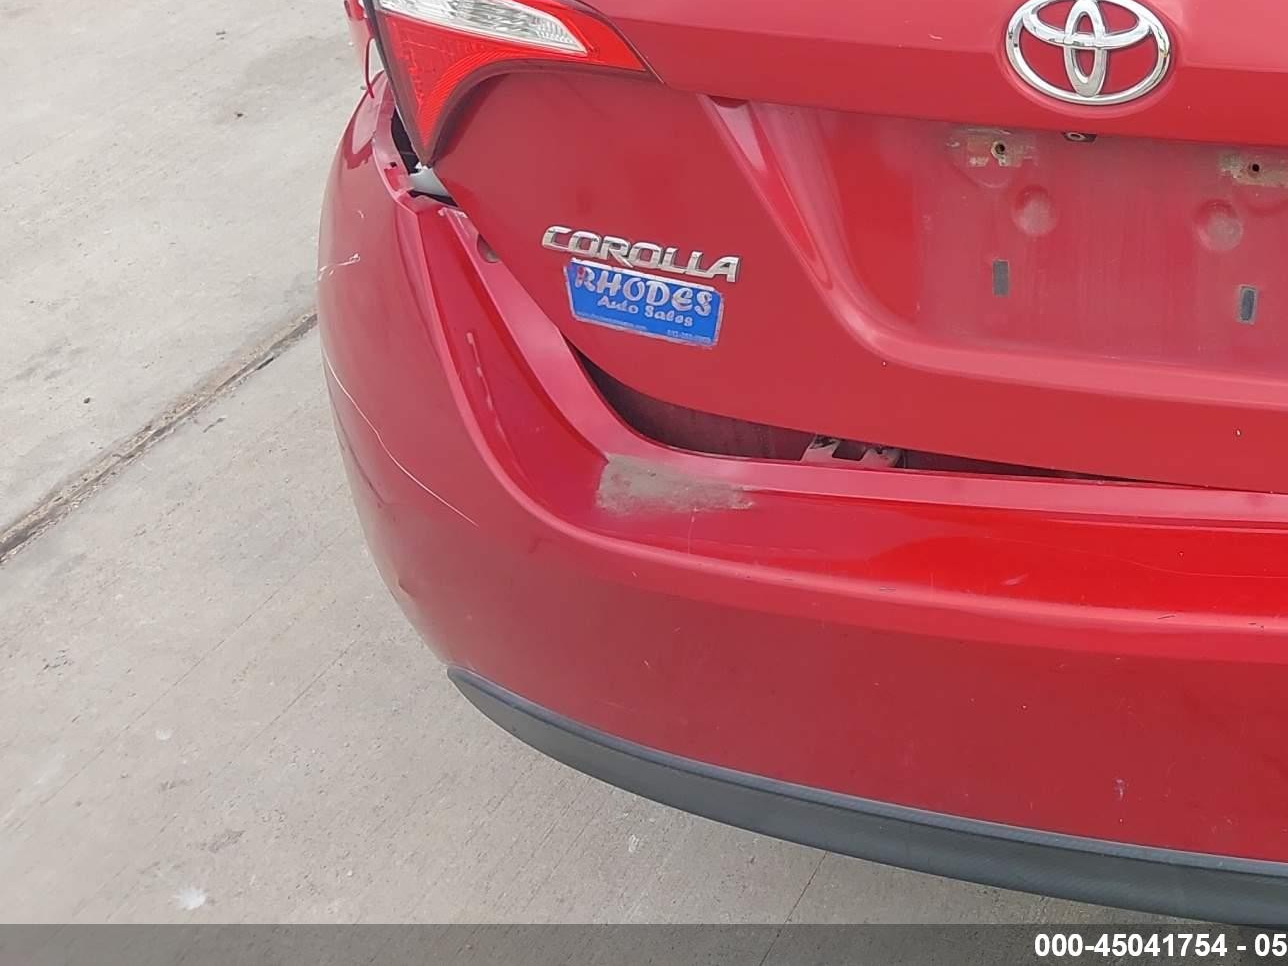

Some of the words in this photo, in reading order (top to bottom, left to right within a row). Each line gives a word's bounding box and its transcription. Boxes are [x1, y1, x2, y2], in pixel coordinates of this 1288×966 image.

[542, 225, 740, 283] COROLLA
[597, 295, 639, 315] Auto
[644, 304, 693, 327] Sales
